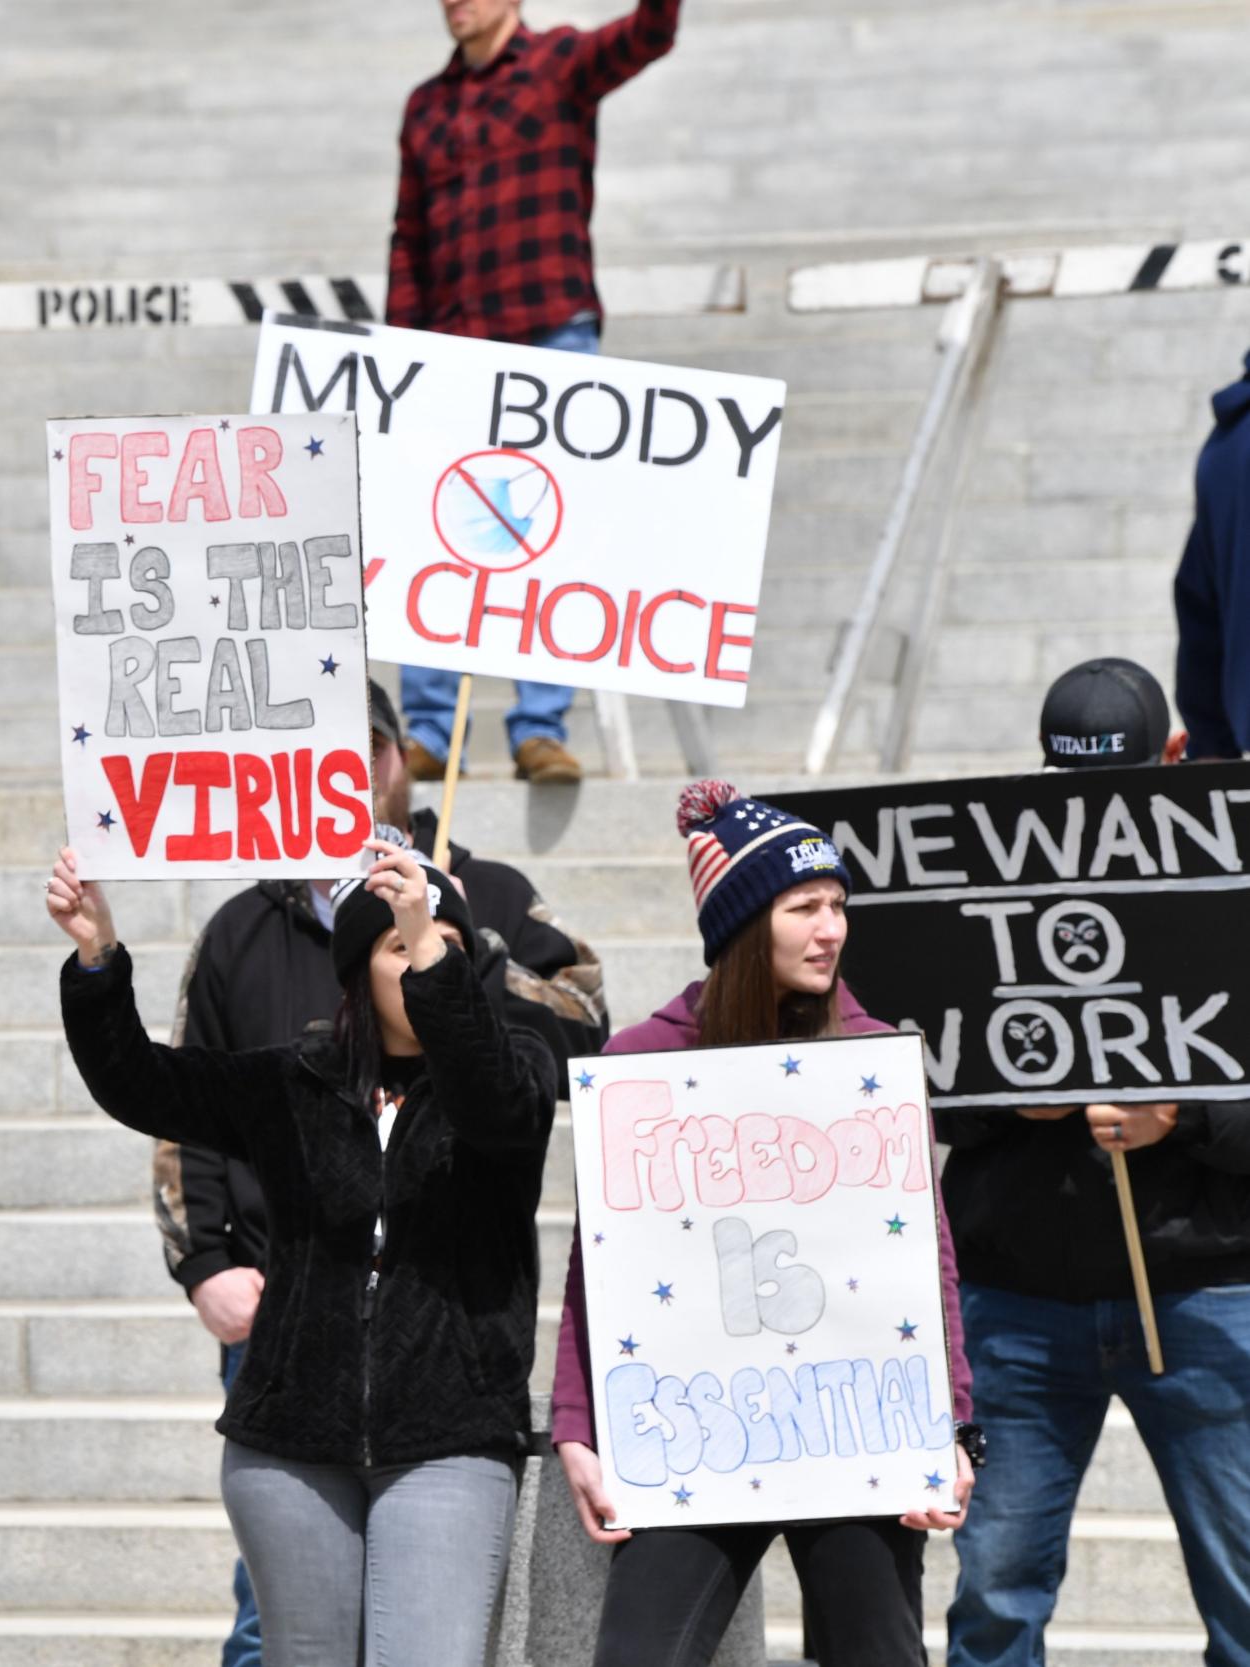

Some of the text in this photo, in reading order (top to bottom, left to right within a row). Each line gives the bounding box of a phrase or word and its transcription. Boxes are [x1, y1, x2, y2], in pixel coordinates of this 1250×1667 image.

[38, 284, 191, 327] POLICE
[271, 342, 782, 478] MY BODY
[68, 426, 288, 530] FEAR
[70, 534, 359, 634] IS THE
[406, 562, 757, 683] CHOICE
[104, 635, 315, 738] REAL
[1049, 731, 1126, 755] VITALIZE
[101, 748, 372, 861] VIRUS
[785, 841, 838, 862] TRU
[960, 899, 1126, 987] TO
[712, 1216, 827, 1338] IS
[604, 1354, 953, 1487] ESSENTIAL
